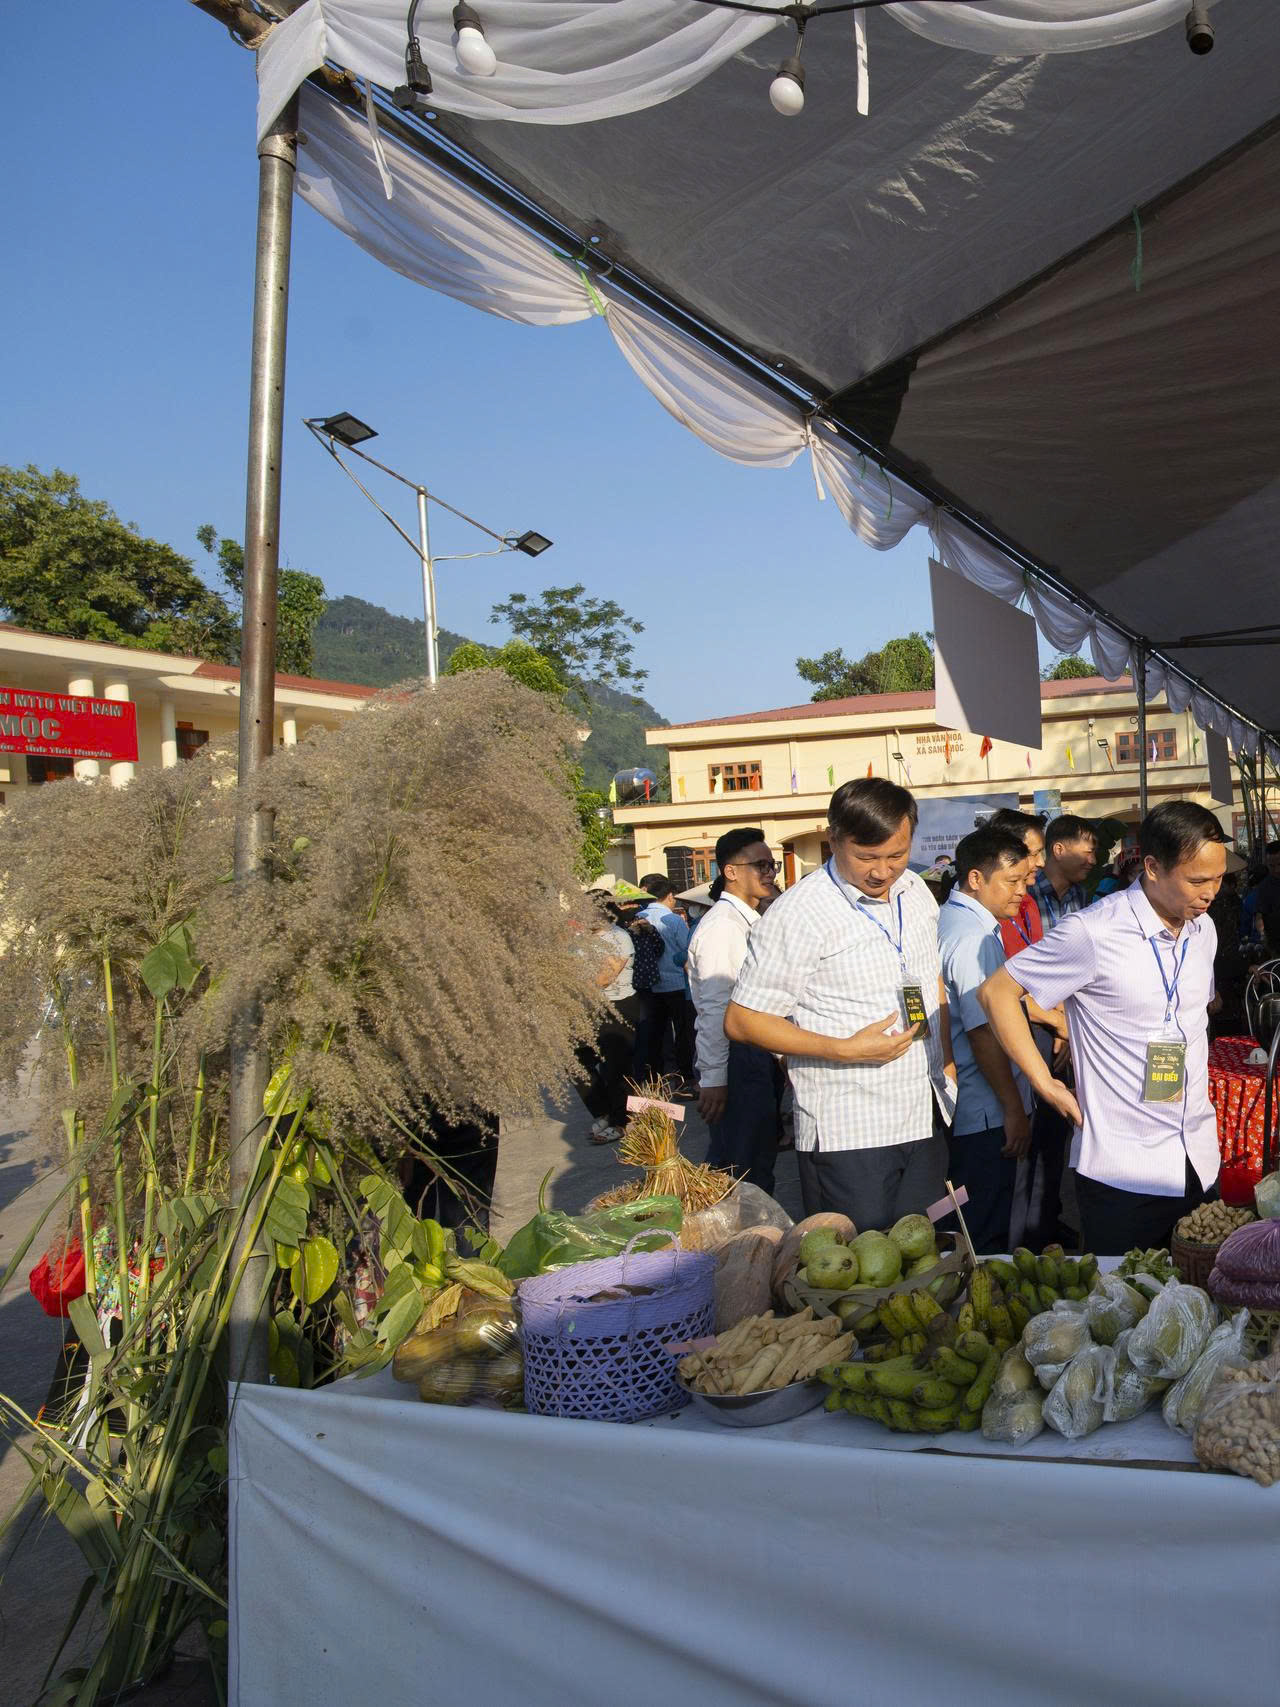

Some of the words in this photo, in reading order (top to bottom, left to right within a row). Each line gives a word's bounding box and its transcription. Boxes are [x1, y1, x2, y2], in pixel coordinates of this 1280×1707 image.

[14, 693, 55, 711] MTTQ
[59, 697, 88, 715] VIỆT
[91, 702, 123, 717] NAM
[0, 711, 61, 743] MỘC
[931, 732, 946, 743] VĂN
